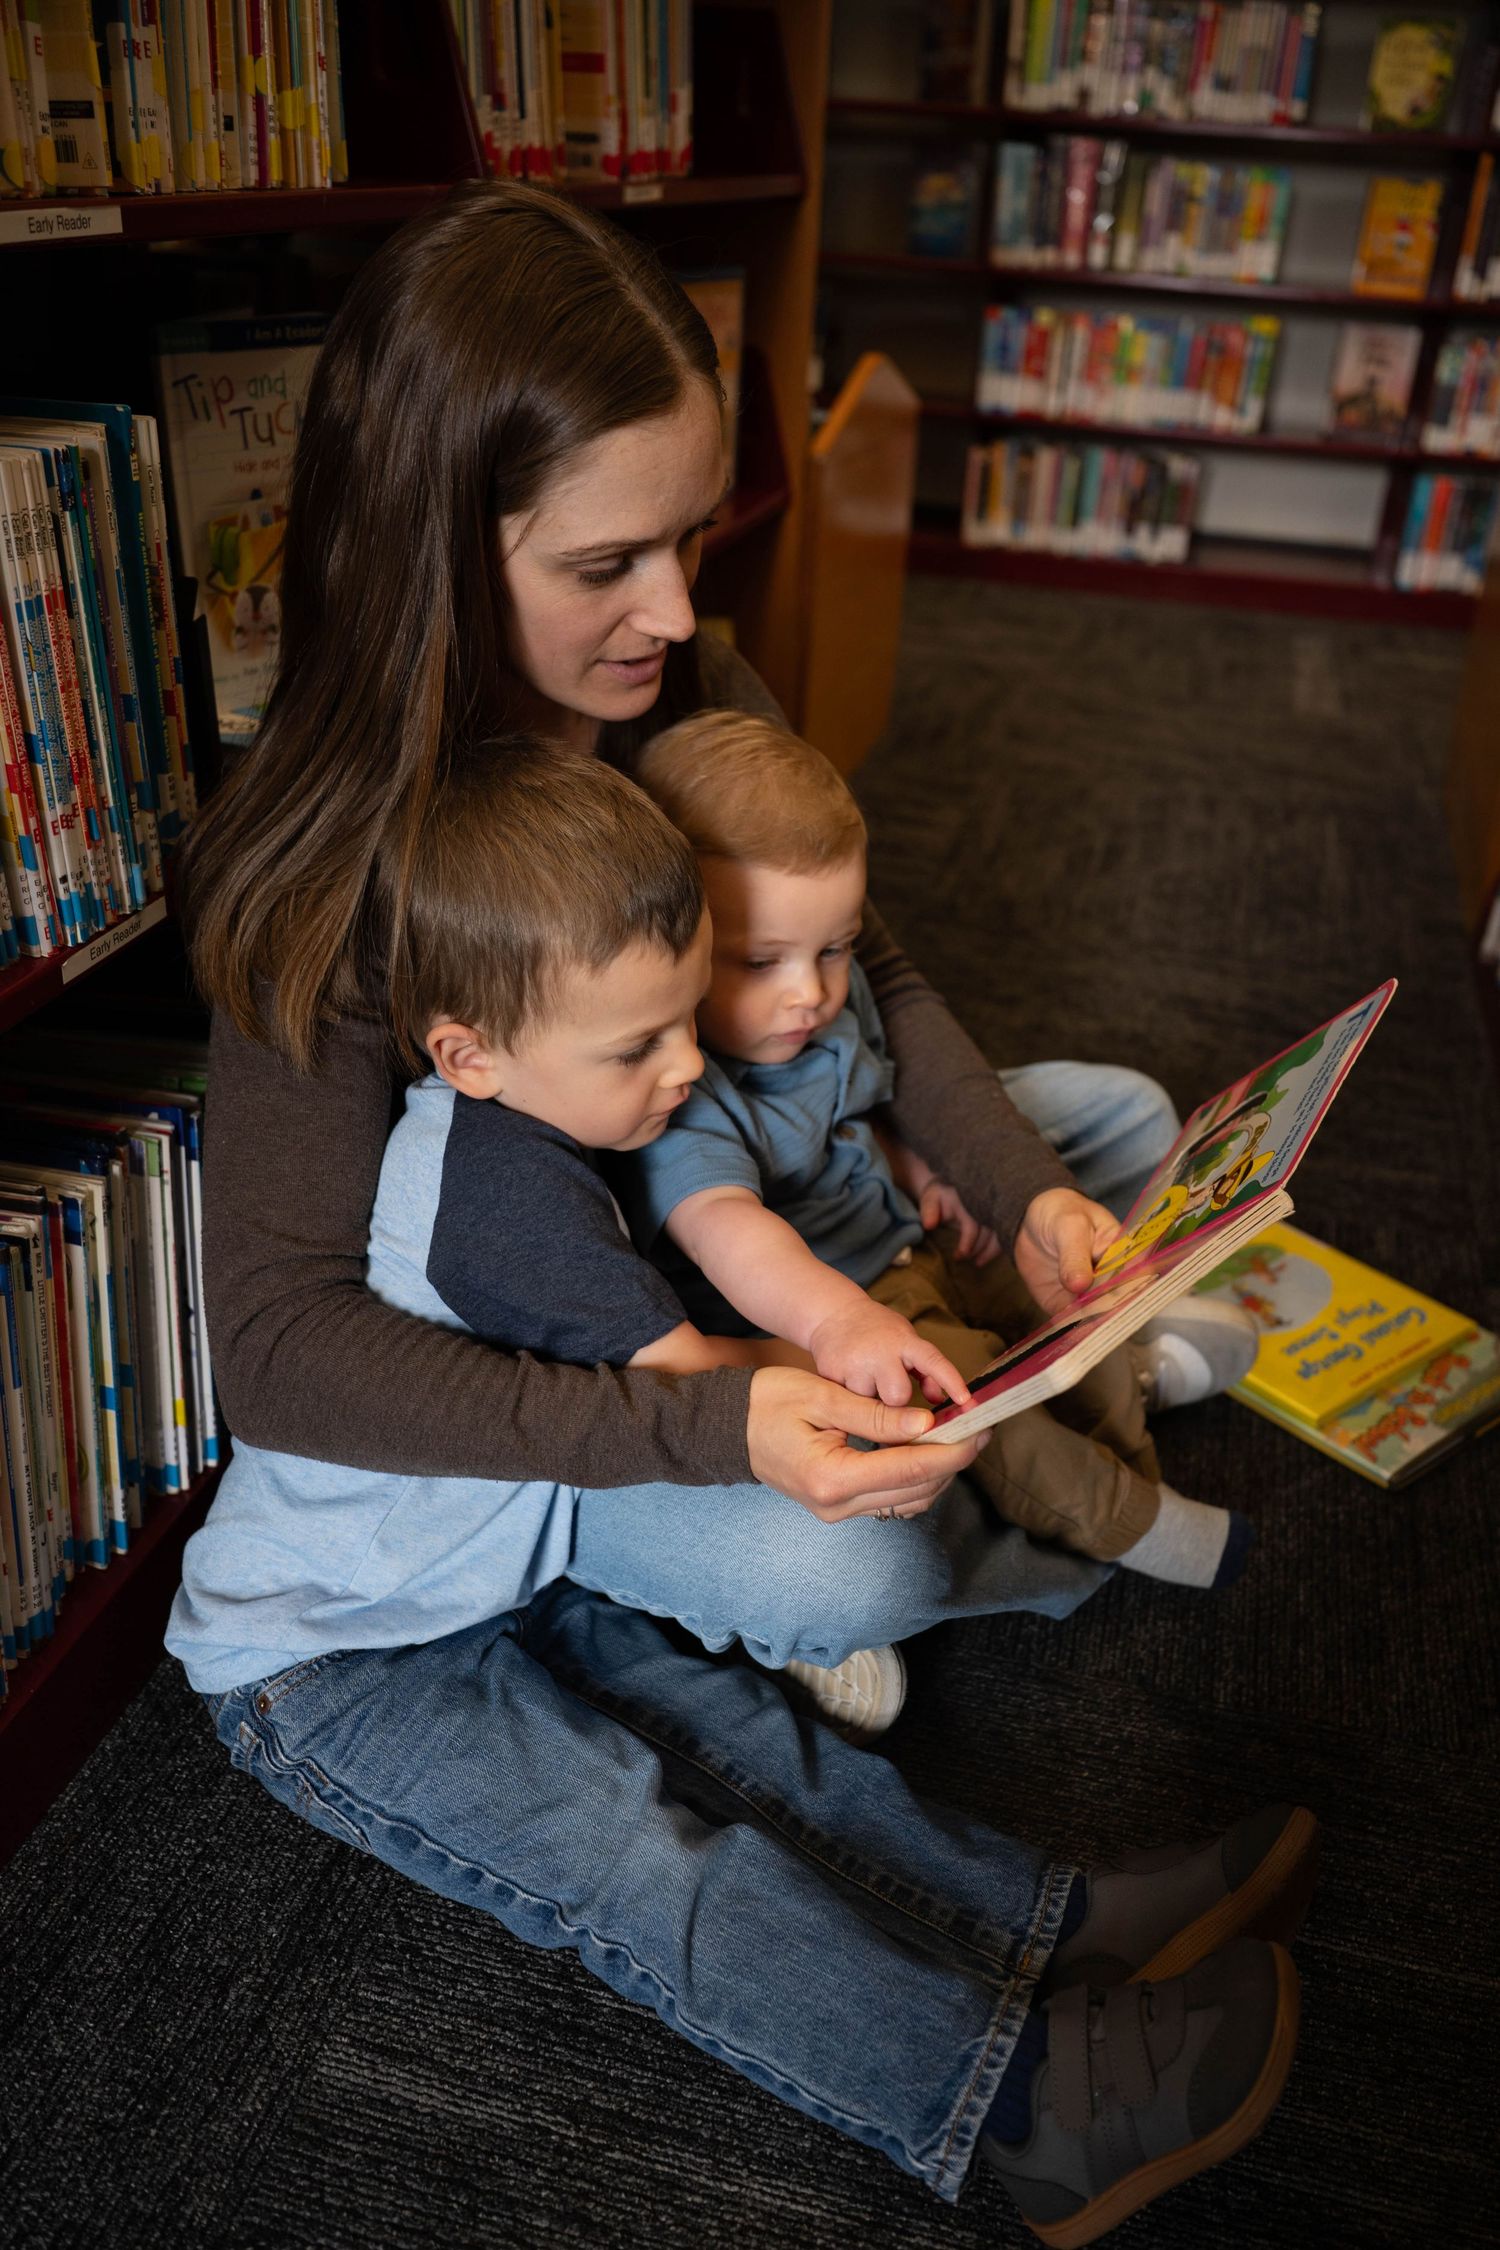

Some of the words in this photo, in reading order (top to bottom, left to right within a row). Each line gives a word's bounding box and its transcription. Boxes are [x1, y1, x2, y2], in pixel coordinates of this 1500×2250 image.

[28, 215, 54, 234] Early
[56, 214, 92, 231] Reader
[172, 373, 234, 430] Tip
[248, 367, 287, 400] and
[230, 402, 296, 450] Tuc
[51, 821, 59, 836] E
[90, 940, 112, 961] Early
[112, 919, 142, 944] Reader
